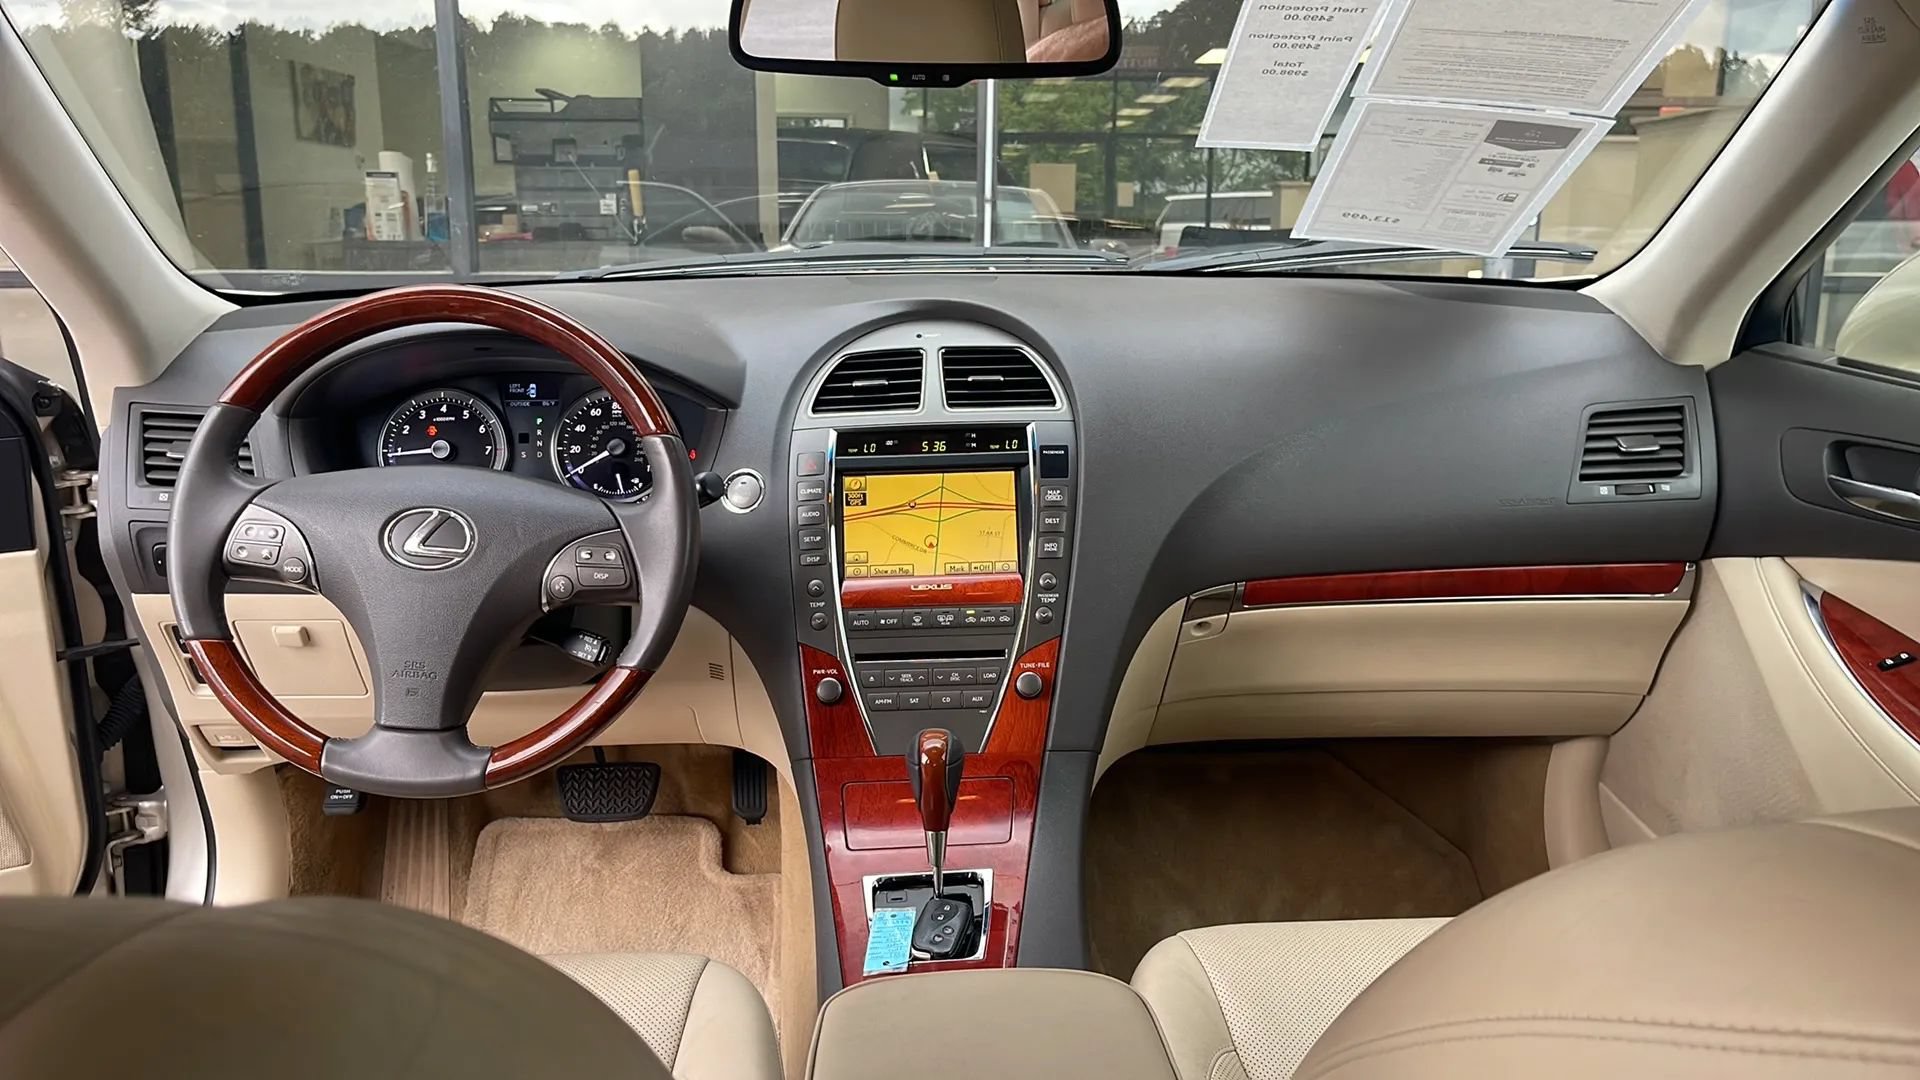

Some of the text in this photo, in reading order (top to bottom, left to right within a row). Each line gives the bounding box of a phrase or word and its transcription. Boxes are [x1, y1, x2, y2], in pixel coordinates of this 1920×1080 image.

[440, 404, 447, 413] 4
[419, 410, 426, 419] 3
[462, 410, 470, 419] 5
[402, 425, 410, 434] 2
[479, 425, 486, 434] 6
[574, 424, 586, 432] 40
[864, 444, 876, 453] LO
[1006, 440, 1018, 449] LO
[485, 446, 492, 455] 7
[594, 572, 609, 580] DISP
[404, 660, 426, 670] SRS
[391, 670, 438, 680] AIRBAG
